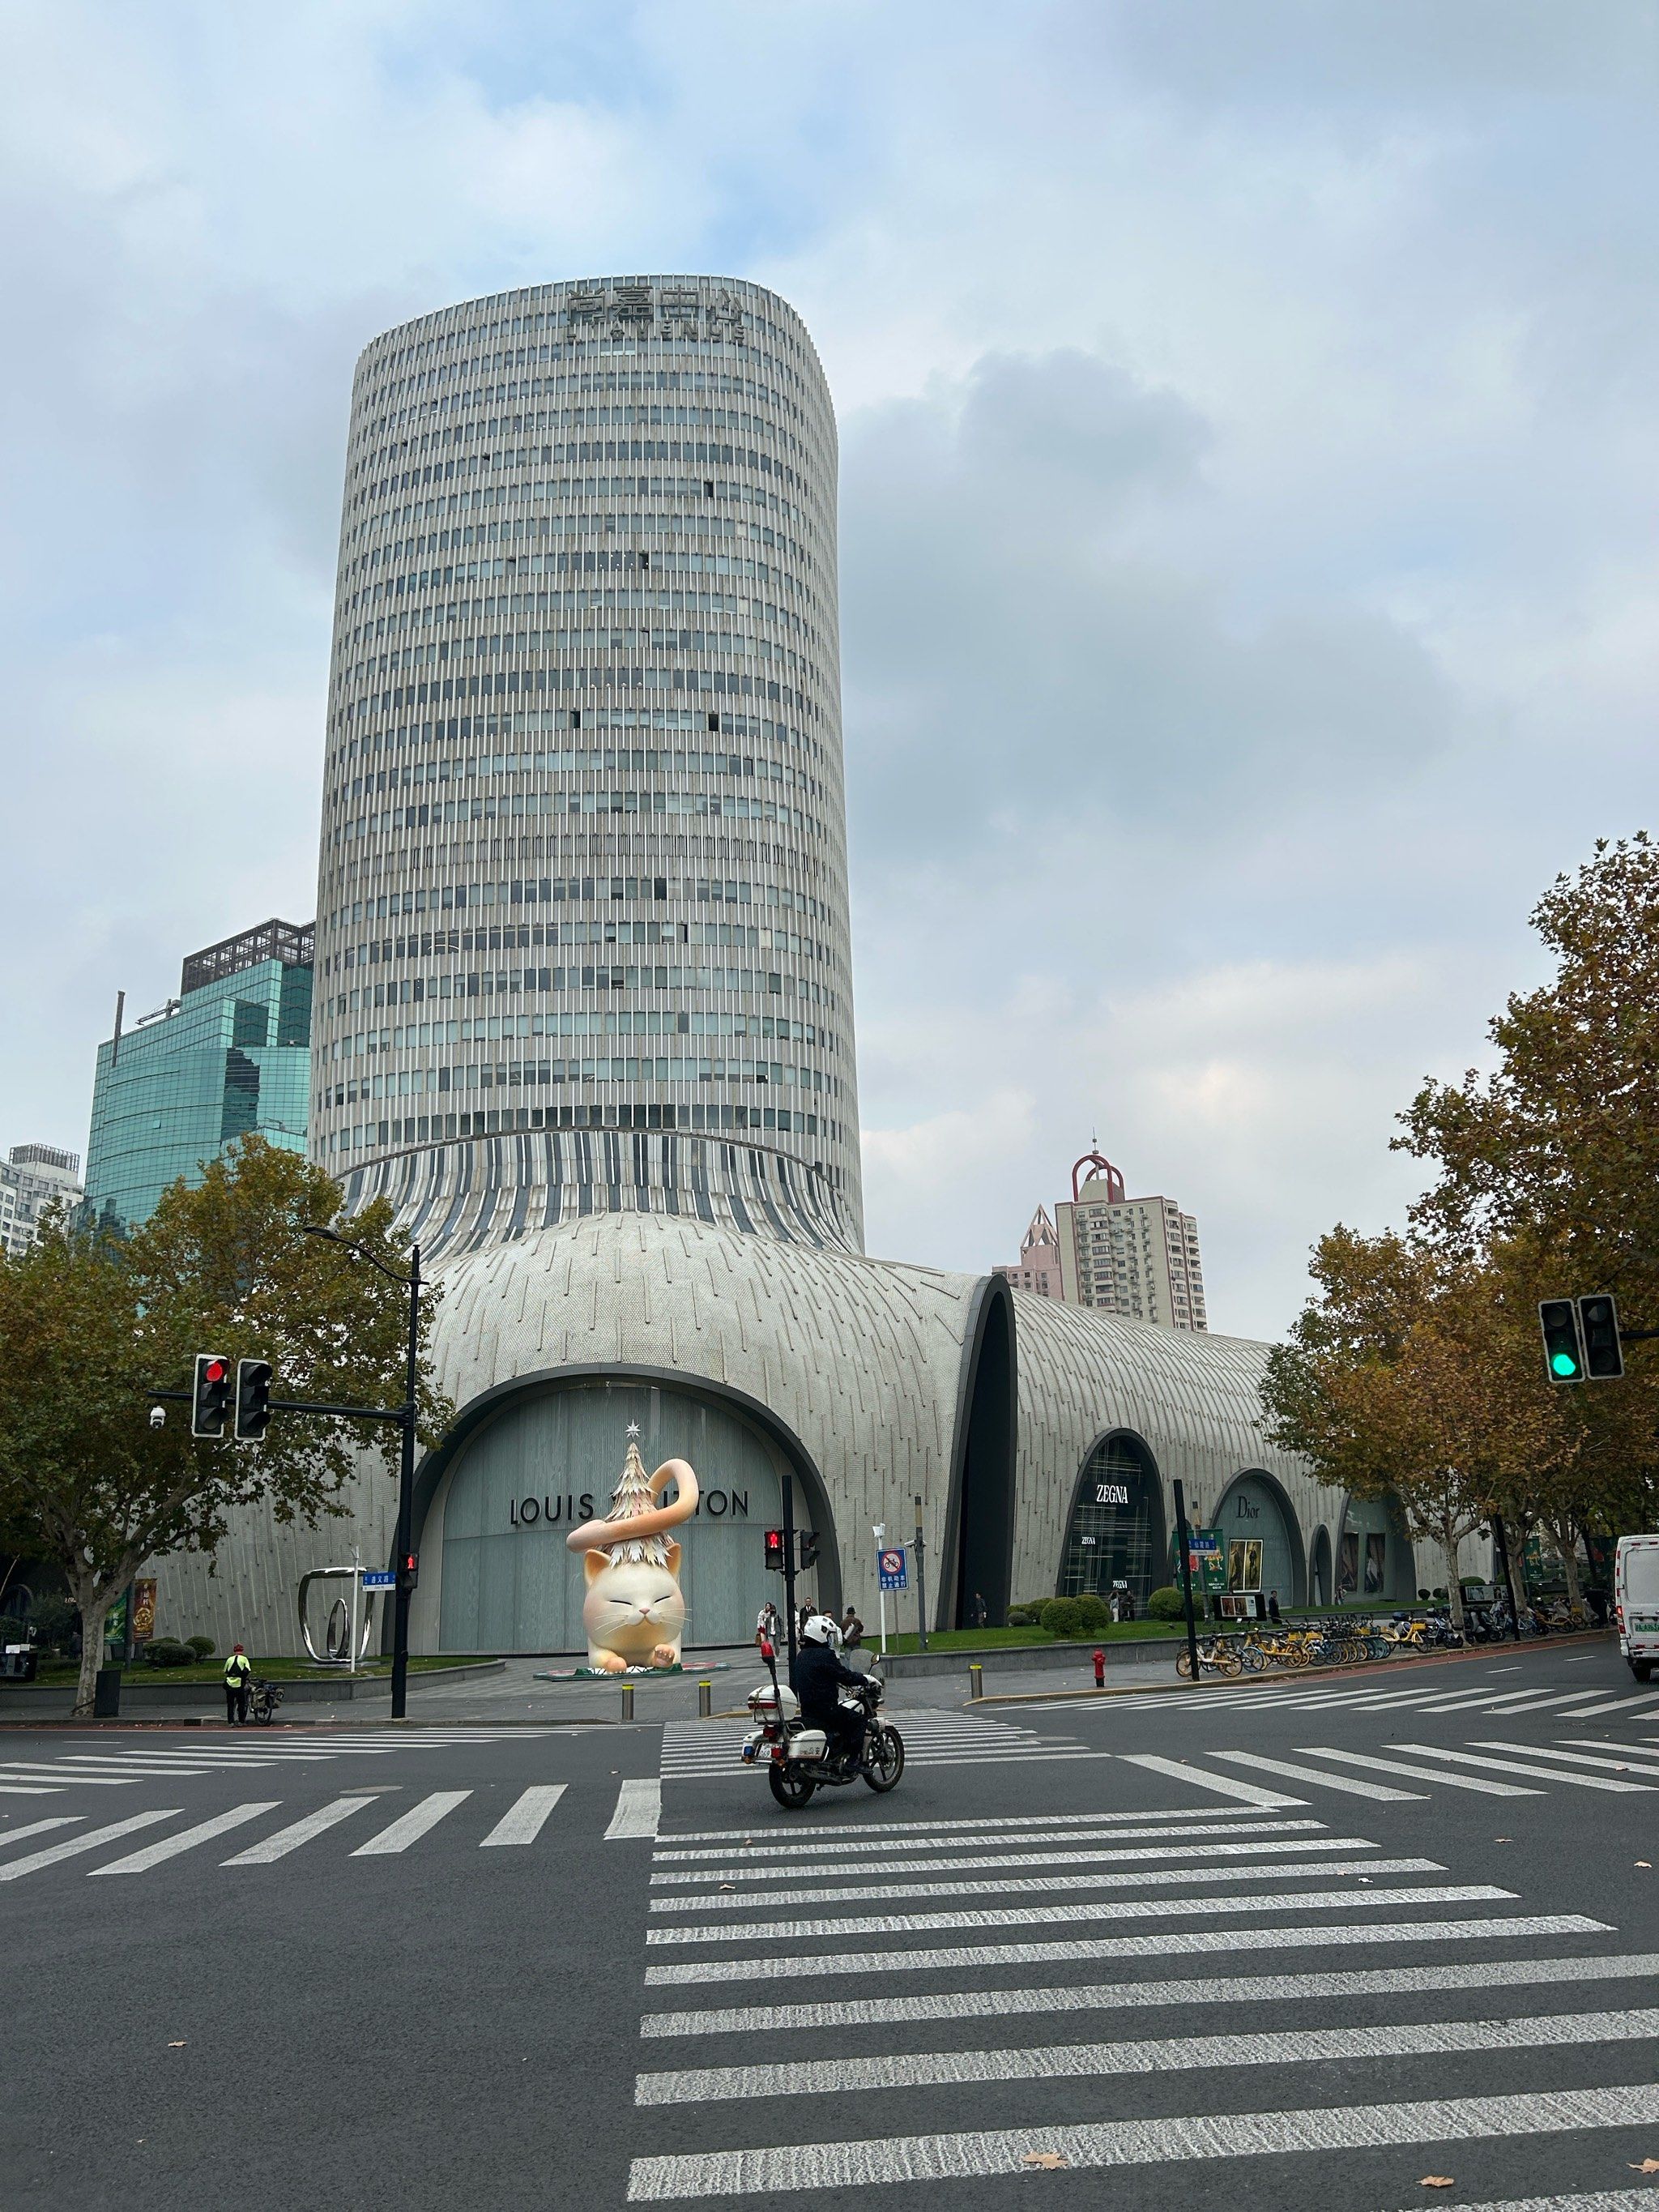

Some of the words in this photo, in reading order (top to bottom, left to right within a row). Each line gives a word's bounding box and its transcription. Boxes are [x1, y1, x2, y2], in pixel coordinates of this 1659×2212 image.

[568, 284, 743, 322] 尚嘉中心
[1096, 1484, 1128, 1504] ZEGNA
[510, 1493, 594, 1524] LOUIS
[1236, 1496, 1260, 1518] Dior
[1081, 1536, 1096, 1545] ZEGNA
